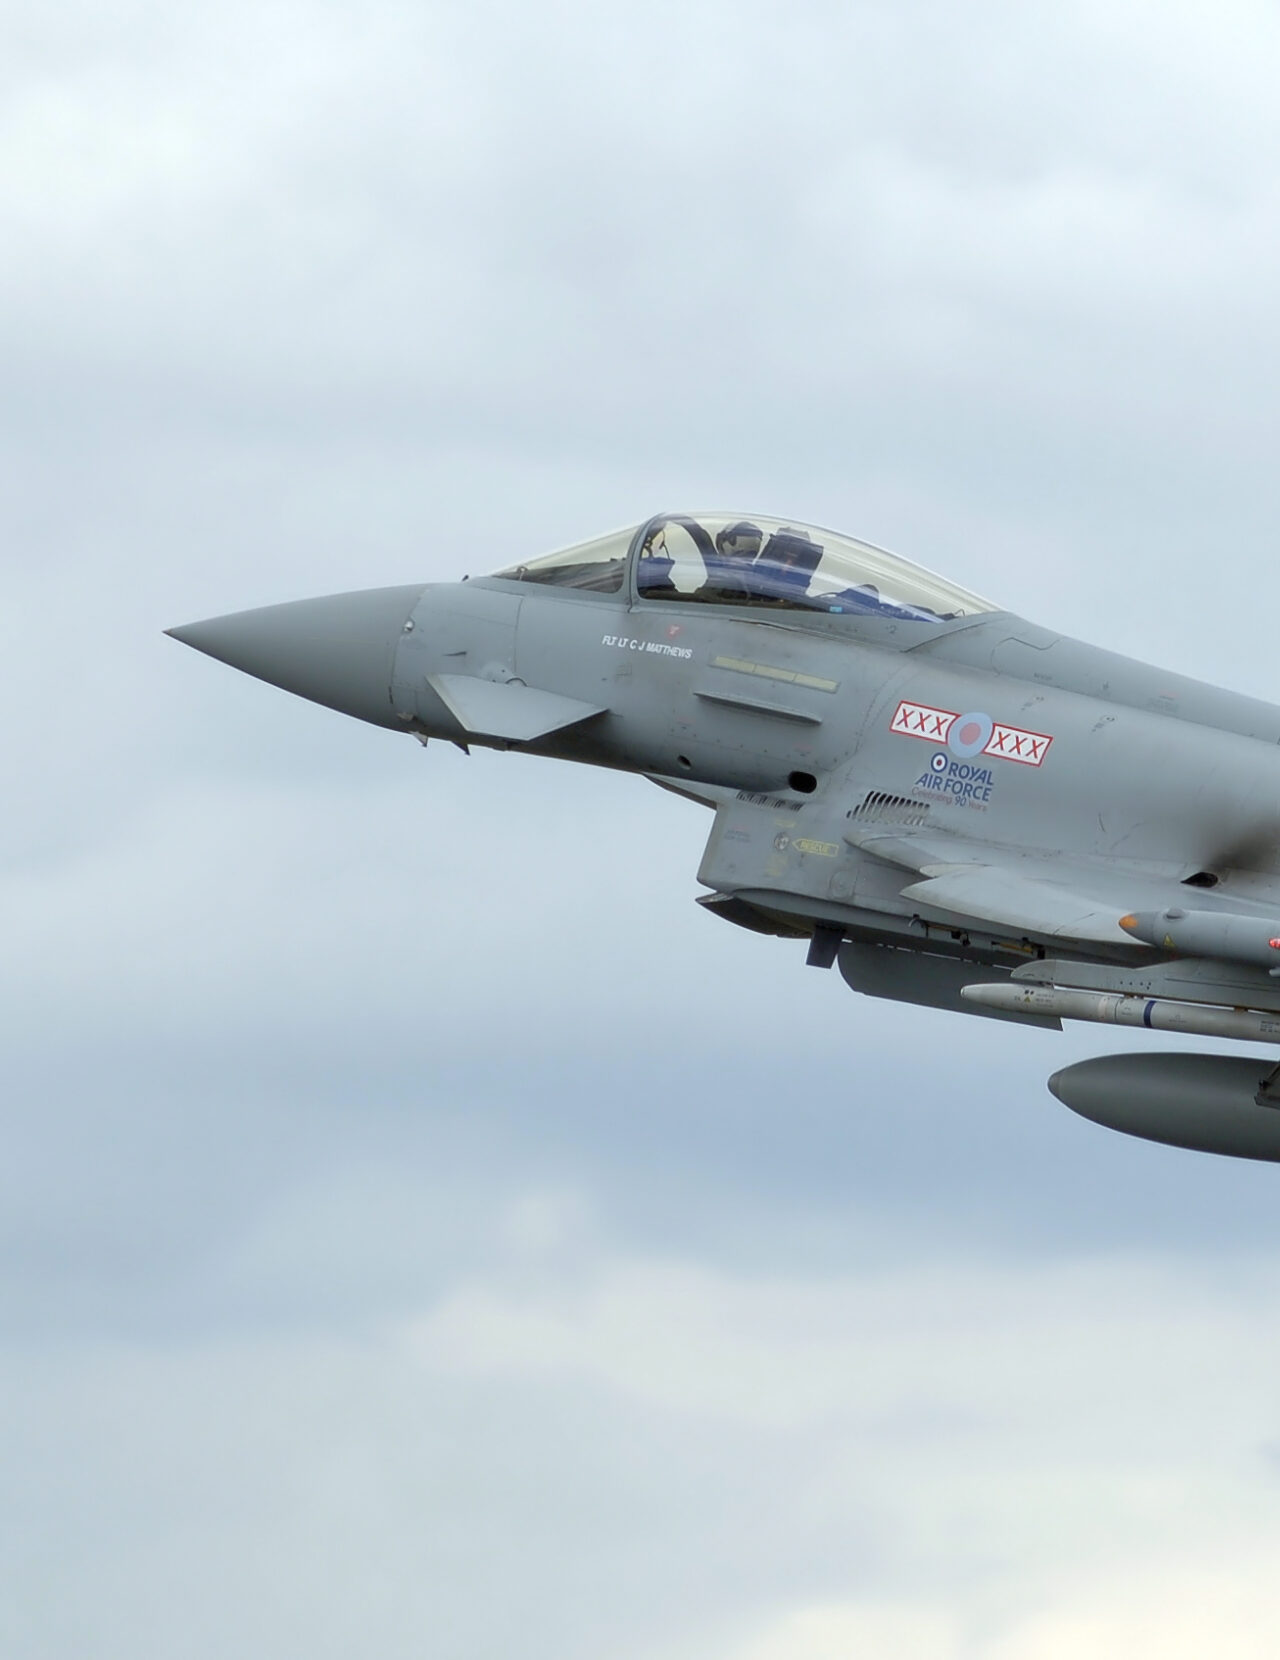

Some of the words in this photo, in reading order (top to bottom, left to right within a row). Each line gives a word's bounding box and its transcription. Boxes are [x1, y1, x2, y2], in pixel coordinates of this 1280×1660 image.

[618, 638, 629, 647] LT
[630, 640, 638, 650] C
[638, 642, 646, 651] J
[646, 643, 693, 659] MATTHEWS
[897, 709, 948, 736] XXX
[992, 732, 1044, 759] XXX
[948, 762, 994, 785] ROYAL
[915, 773, 943, 791] AIR
[943, 779, 992, 802] FORCE
